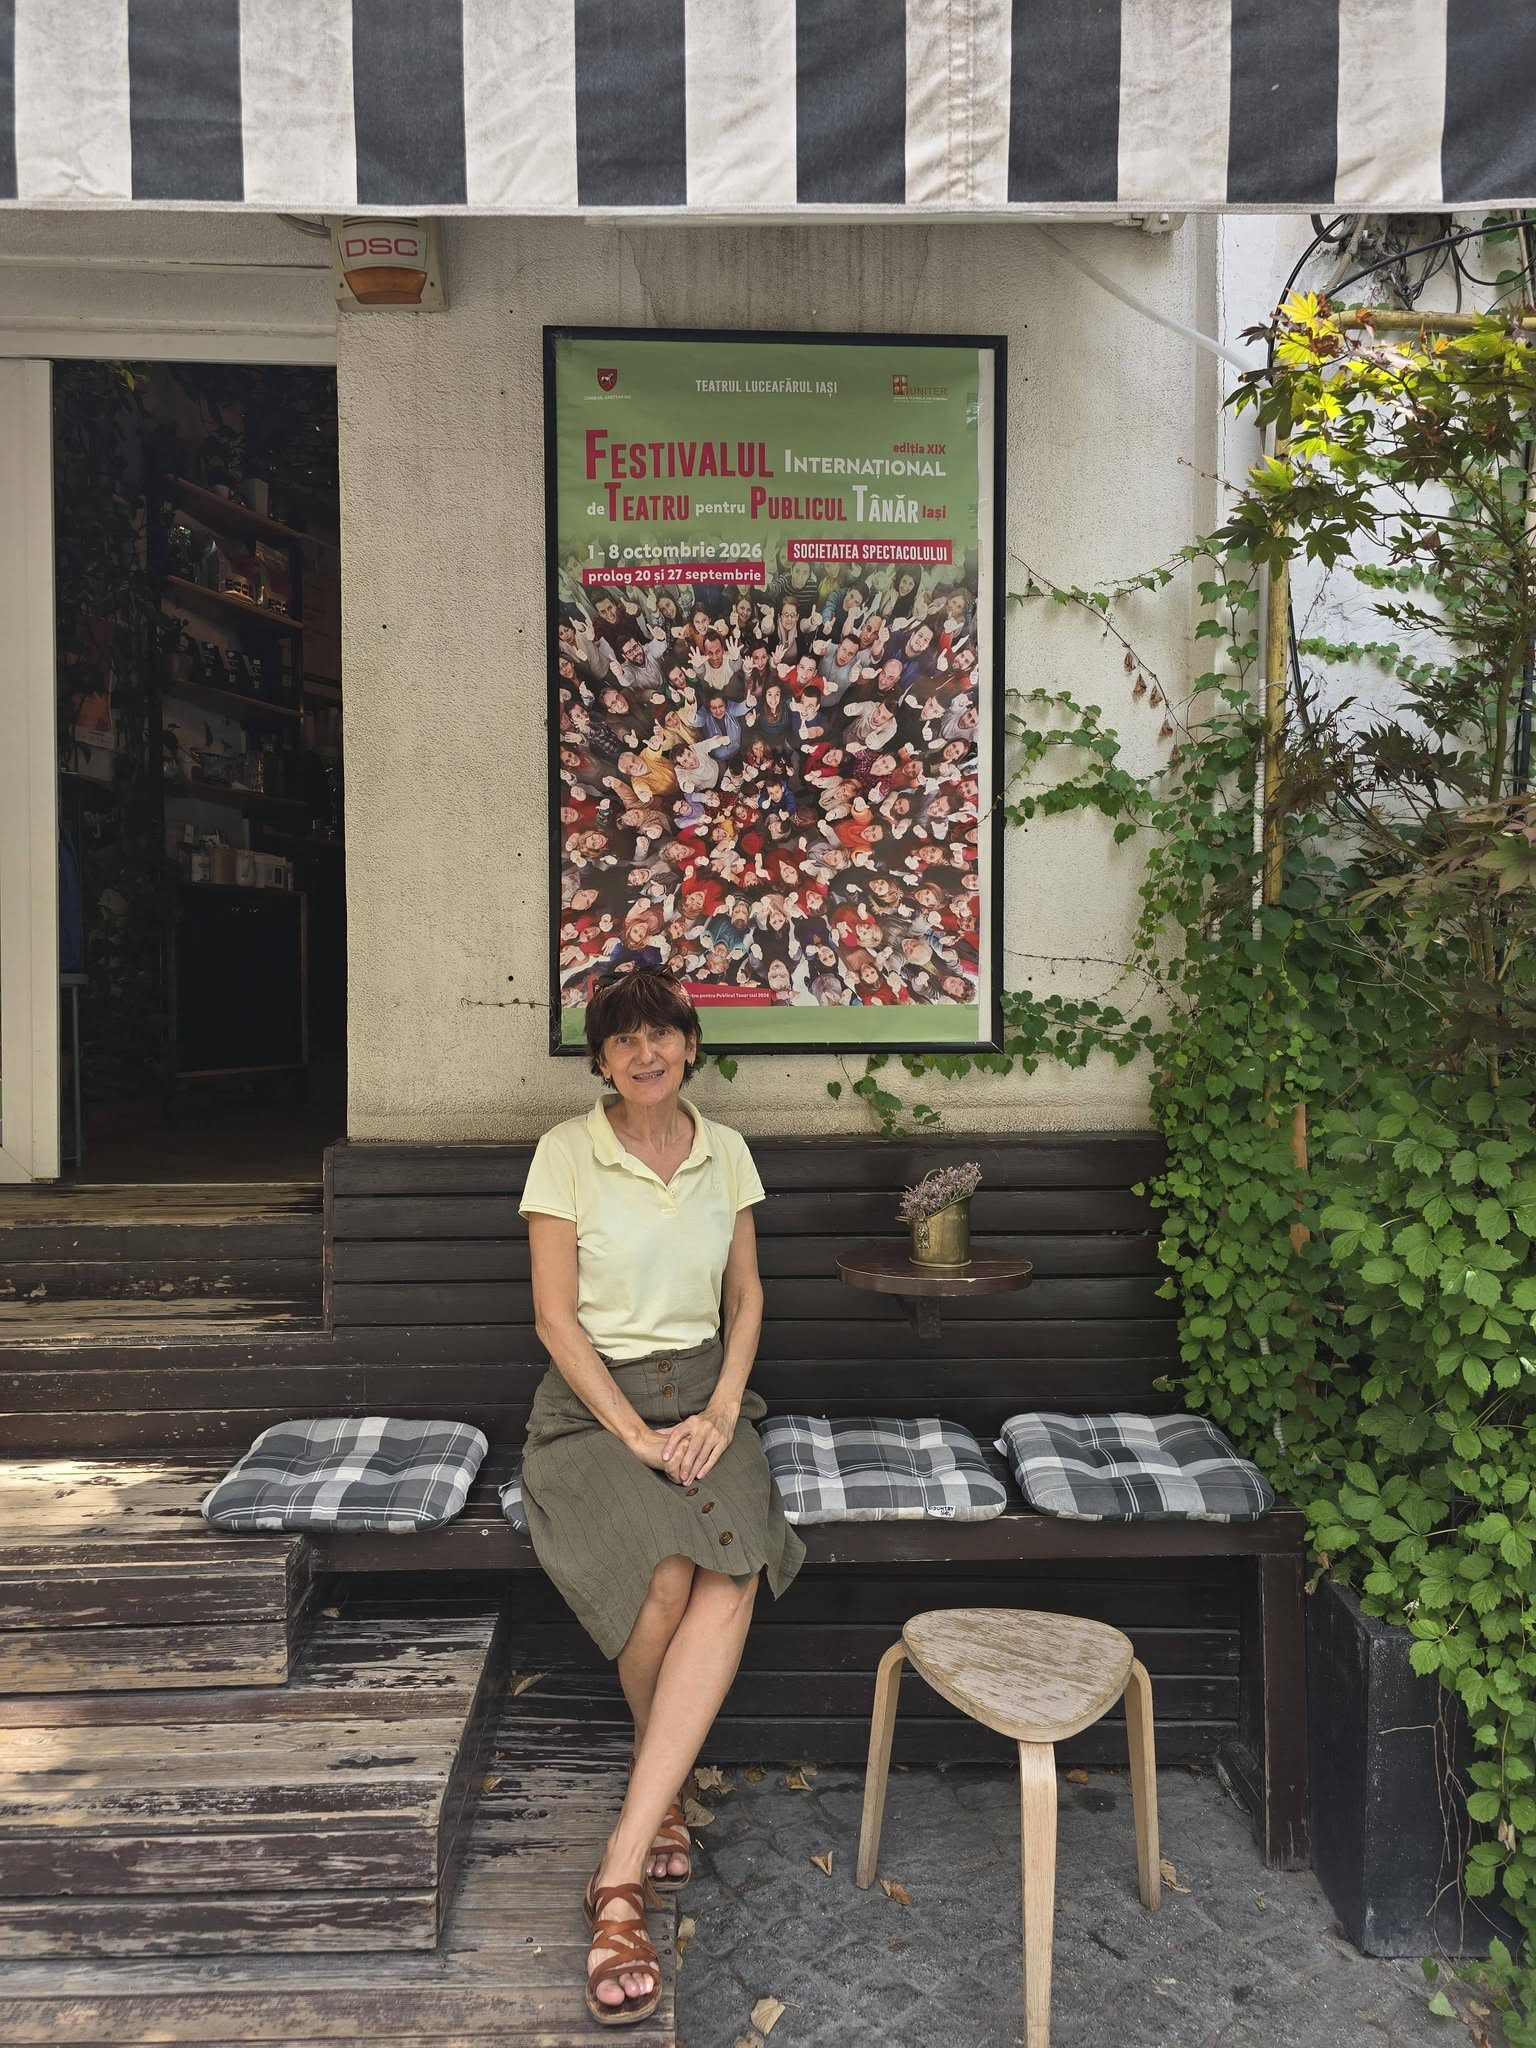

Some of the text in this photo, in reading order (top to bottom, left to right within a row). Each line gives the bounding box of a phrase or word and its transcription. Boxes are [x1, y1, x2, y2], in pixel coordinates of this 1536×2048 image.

[345, 237, 418, 258] DSC
[695, 377, 838, 398] TEATRUL LUCEAFĂRUL IAȘI
[585, 428, 774, 480] FESTIVALUL
[893, 442, 946, 456] ediția XIX
[586, 500, 605, 517] de
[695, 500, 745, 519] pentru
[922, 504, 947, 522] Iași
[587, 544, 595, 560] 1
[608, 544, 620, 559] 8
[623, 541, 716, 560] octombrie
[719, 542, 762, 558] 2026
[793, 543, 948, 561] SOCIETATEA SPECTACOLULUI
[588, 568, 761, 585] prolog 20 și 27 septembrie
